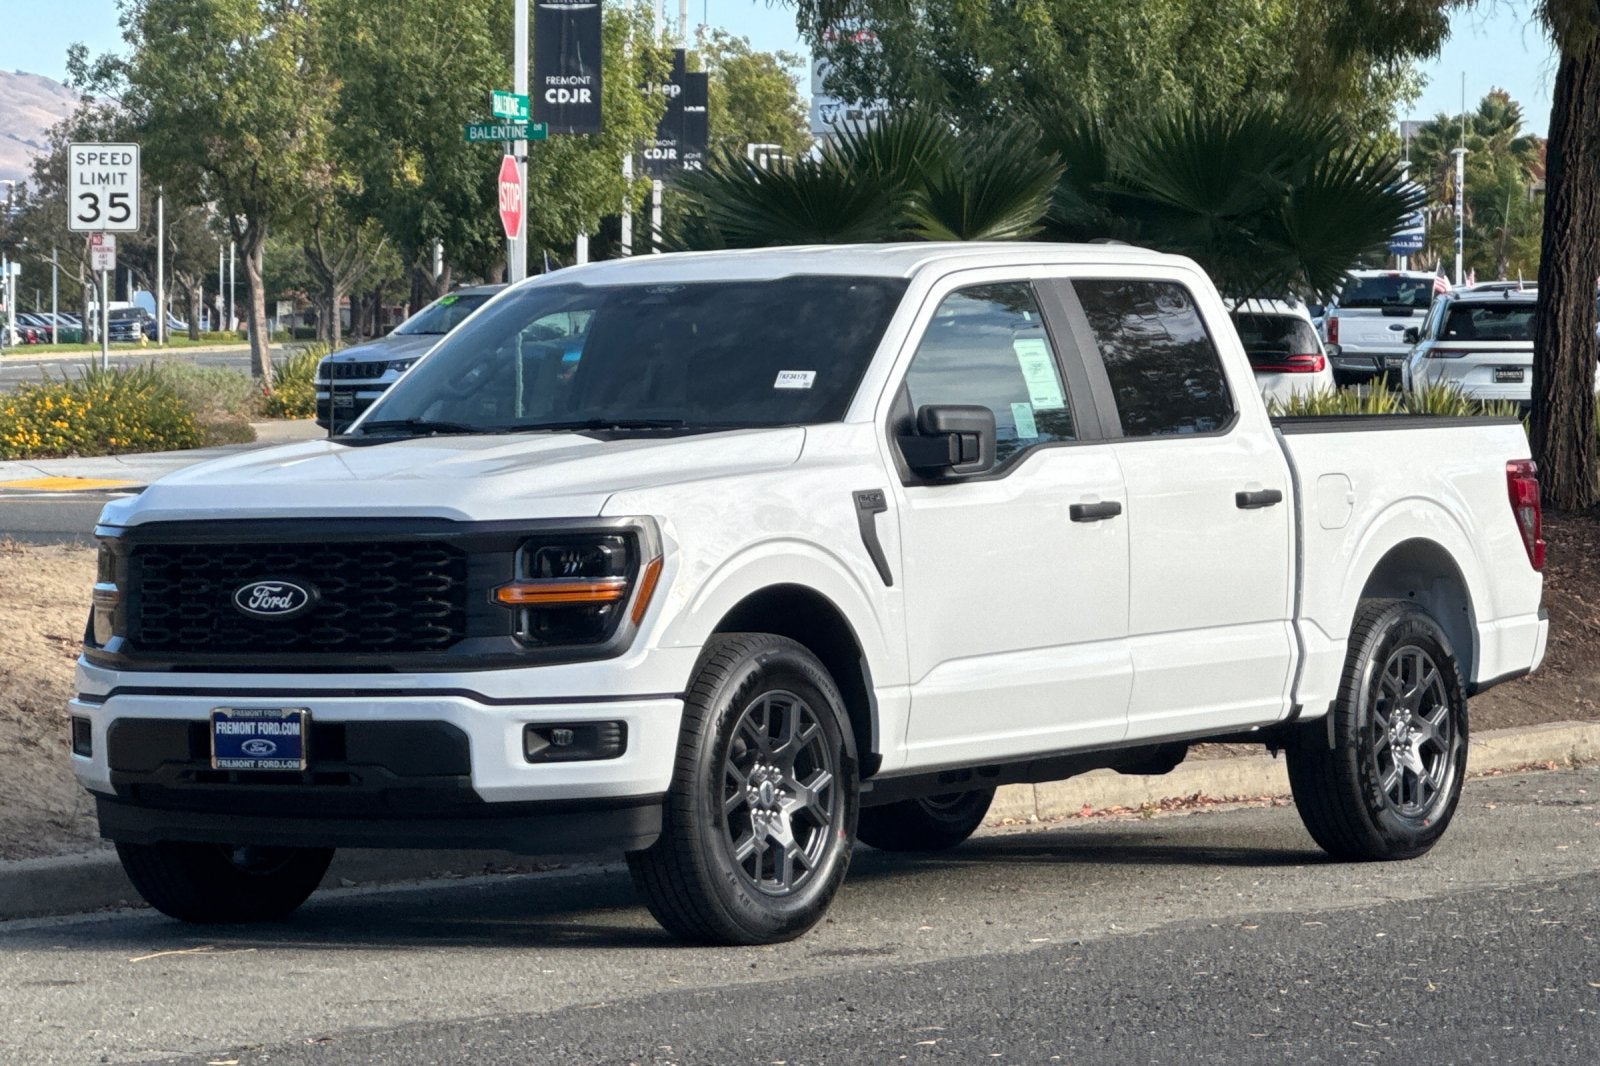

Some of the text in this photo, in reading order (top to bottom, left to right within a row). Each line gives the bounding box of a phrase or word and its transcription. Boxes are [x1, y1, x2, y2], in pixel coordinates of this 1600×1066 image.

[546, 76, 591, 85] FREMONT
[545, 88, 592, 103] CDJR
[642, 82, 681, 98] Jep
[470, 126, 528, 139] BALENTINE
[76, 152, 132, 165] SPEED
[644, 148, 677, 159] CDJR
[80, 172, 127, 185] LIMIT
[501, 183, 520, 213] STOP
[77, 192, 131, 223] 35
[249, 585, 293, 609] Ford
[216, 722, 300, 735] FREMONT FORD.COM
[250, 742, 267, 752] Ford
[217, 760, 255, 768] FREMONT
